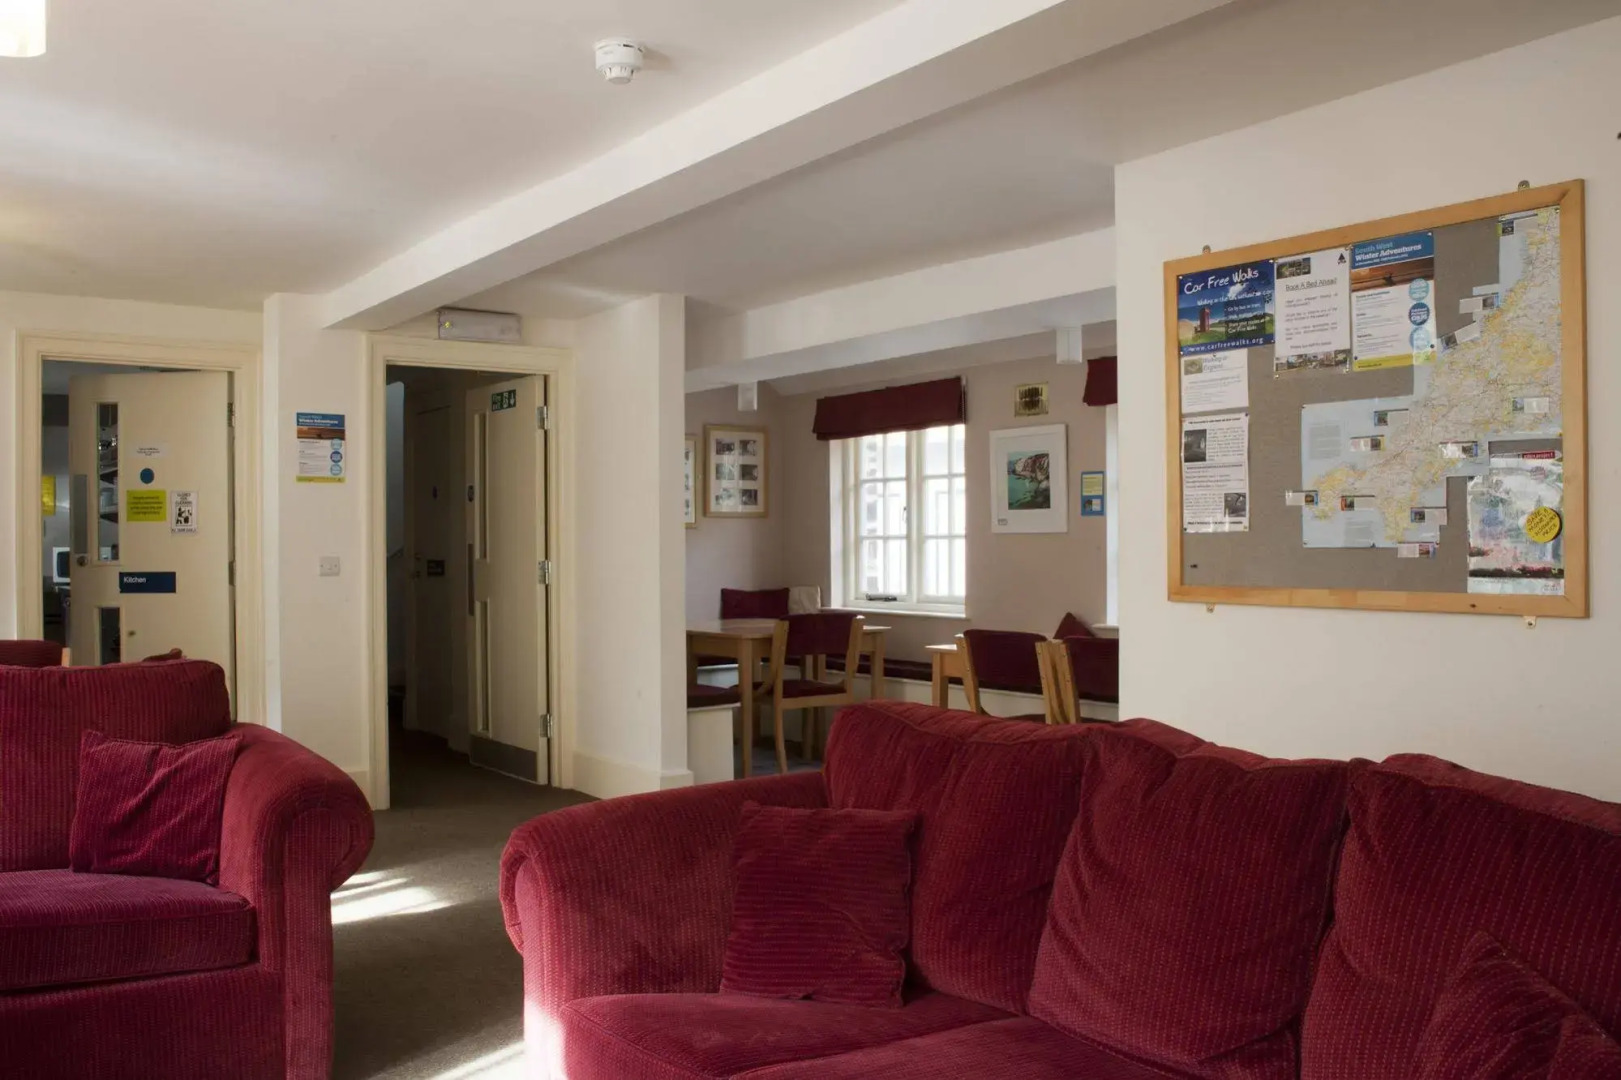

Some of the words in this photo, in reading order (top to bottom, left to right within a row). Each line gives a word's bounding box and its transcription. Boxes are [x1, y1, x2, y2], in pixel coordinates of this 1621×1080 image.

[1355, 252, 1379, 261] Winter
[1380, 244, 1422, 257] Adventures
[1184, 282, 1205, 295] Car
[1207, 276, 1230, 289] Free
[1232, 268, 1259, 283] Walks
[123, 576, 147, 584] Kitchen
